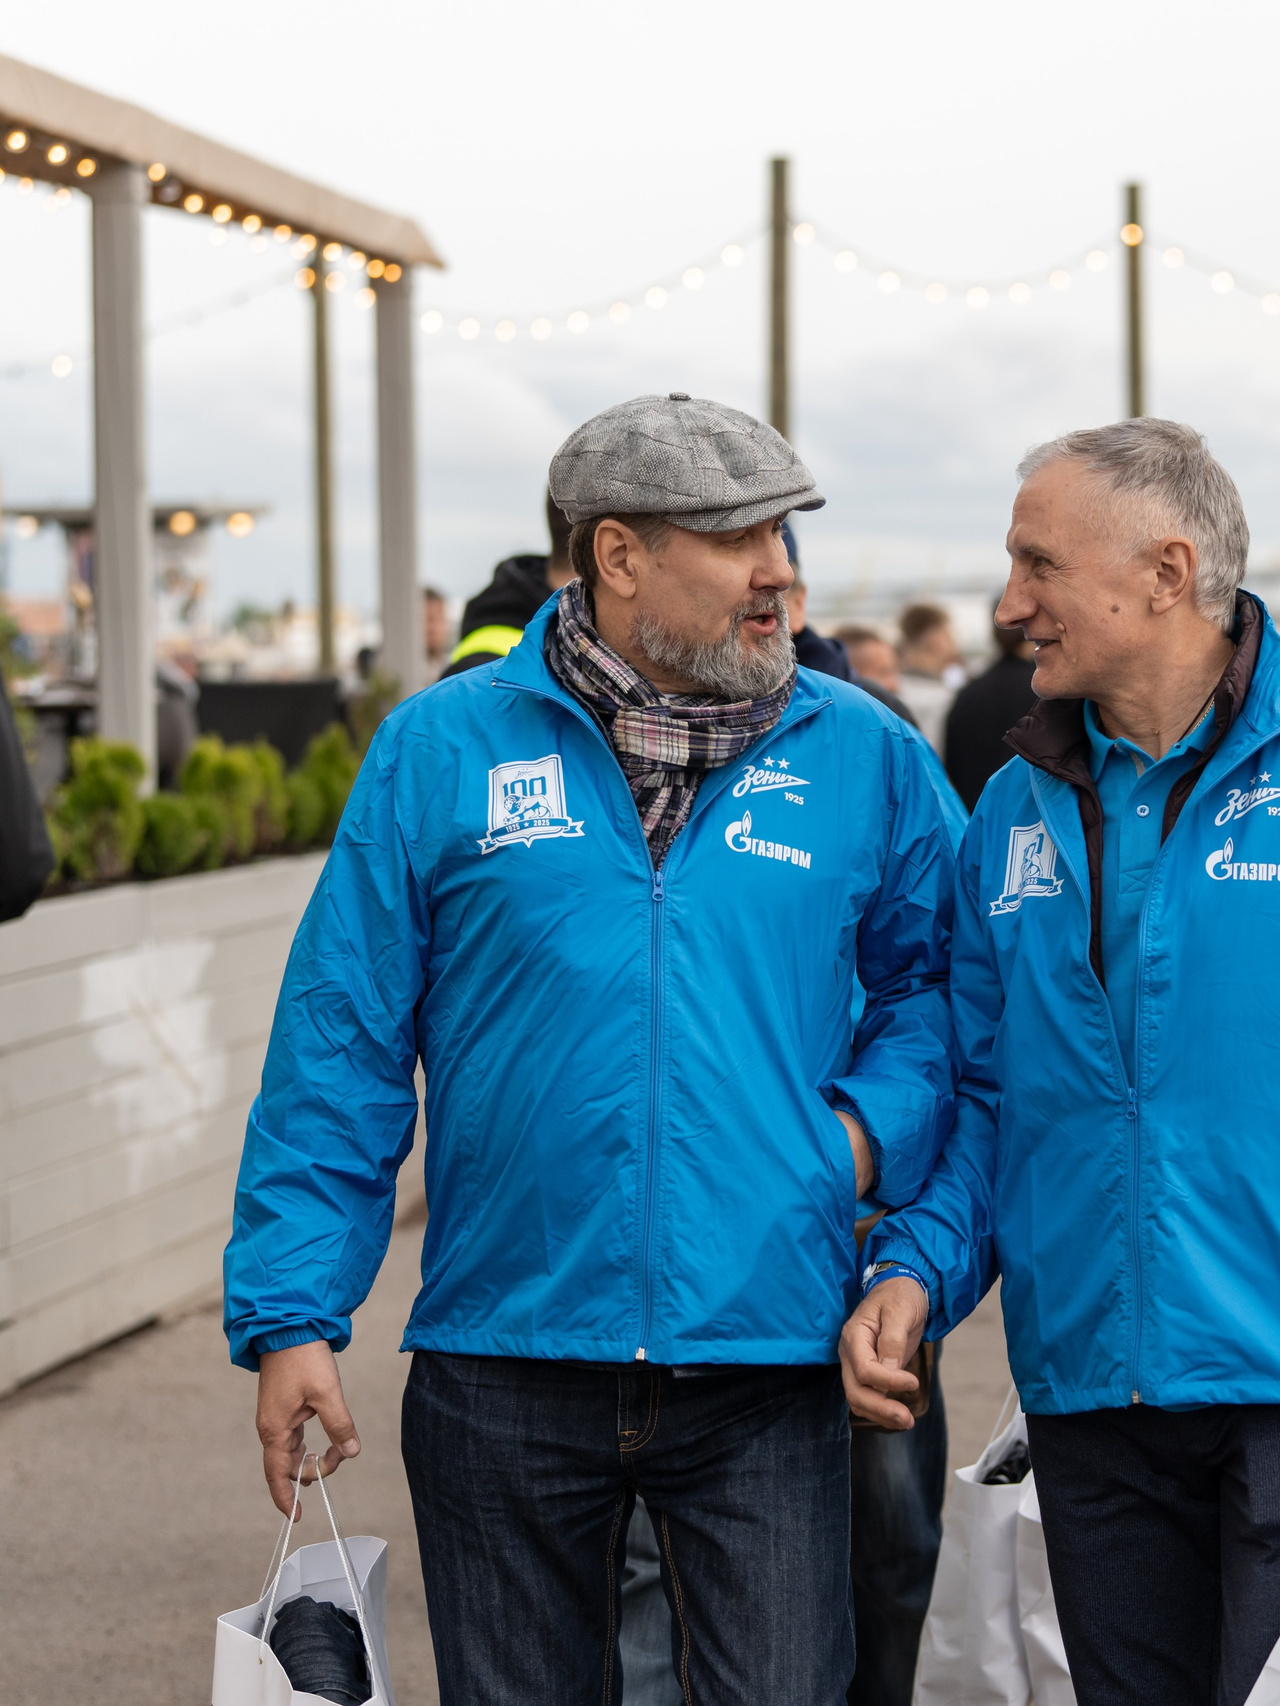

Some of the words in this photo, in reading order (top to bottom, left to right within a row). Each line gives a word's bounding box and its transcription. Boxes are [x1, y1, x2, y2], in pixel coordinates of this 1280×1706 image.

[732, 765, 811, 798] Зенит
[783, 791, 805, 806] 1925
[506, 823, 521, 834] 1925
[533, 819, 550, 828] 2025
[751, 838, 811, 870] ГАЗПРОМ
